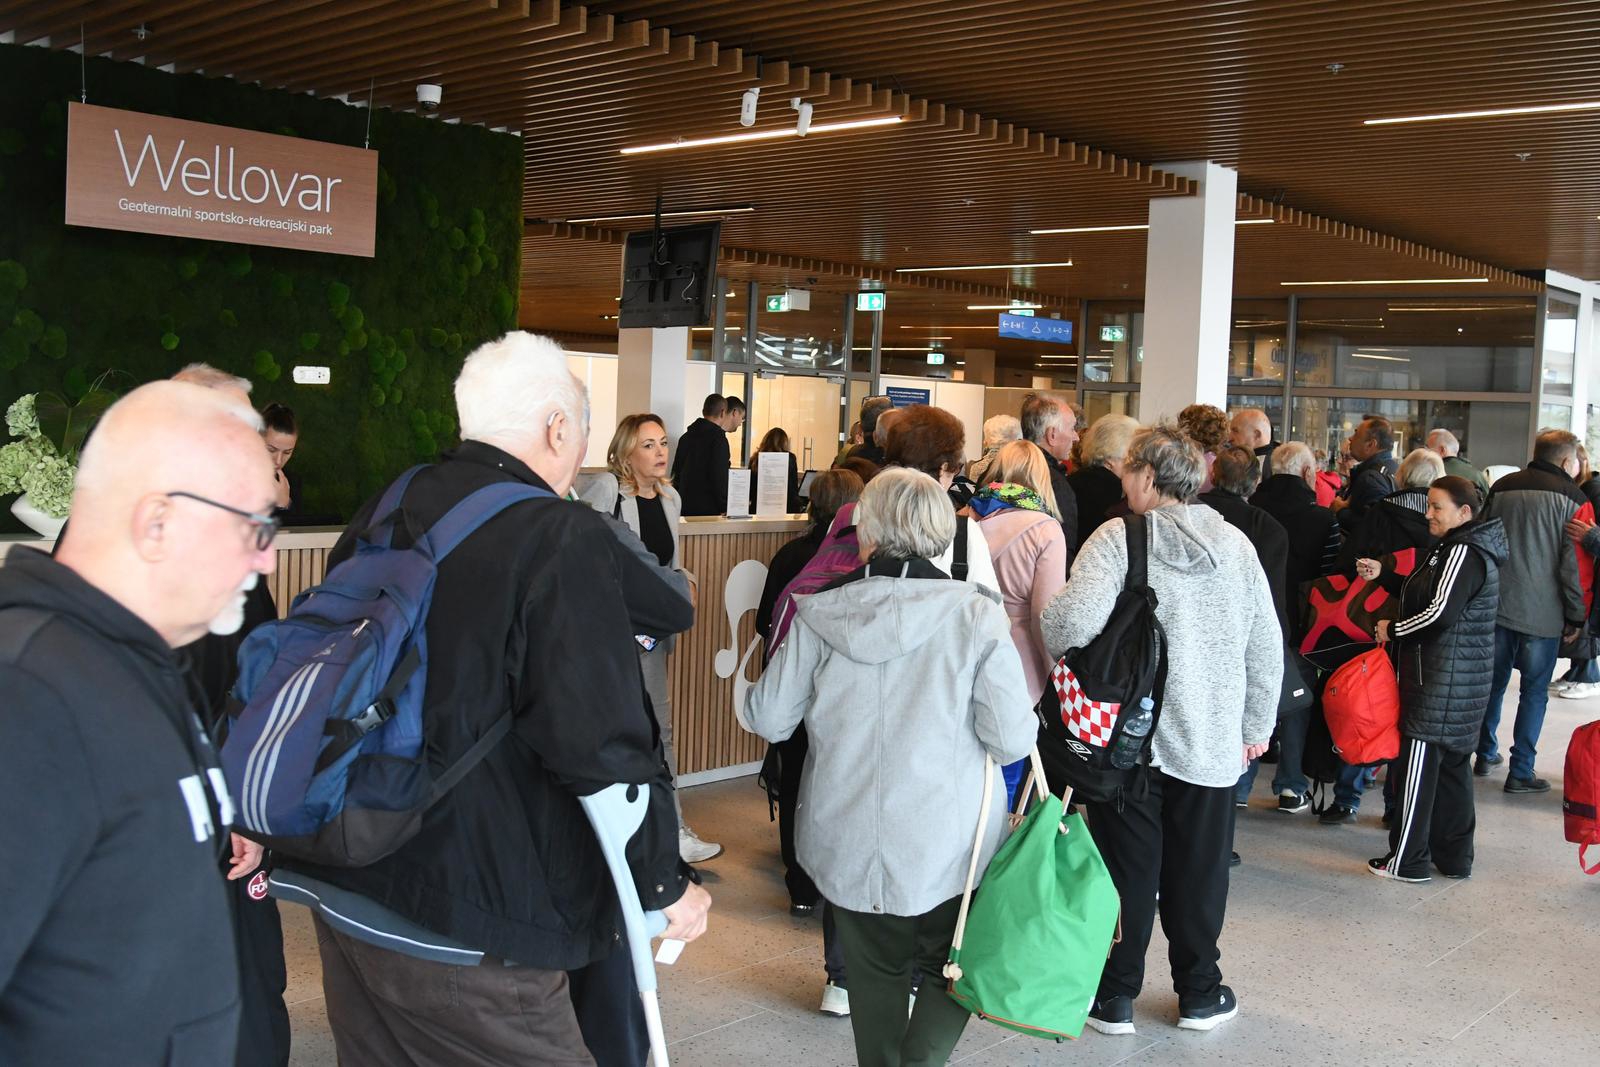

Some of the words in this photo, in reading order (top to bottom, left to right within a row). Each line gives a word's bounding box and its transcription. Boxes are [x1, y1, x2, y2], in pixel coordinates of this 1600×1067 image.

[115, 129, 342, 212] Wellovar
[118, 198, 192, 218] Geotermalni
[195, 210, 307, 233] sportsko-rekreacijski
[309, 223, 333, 235] park
